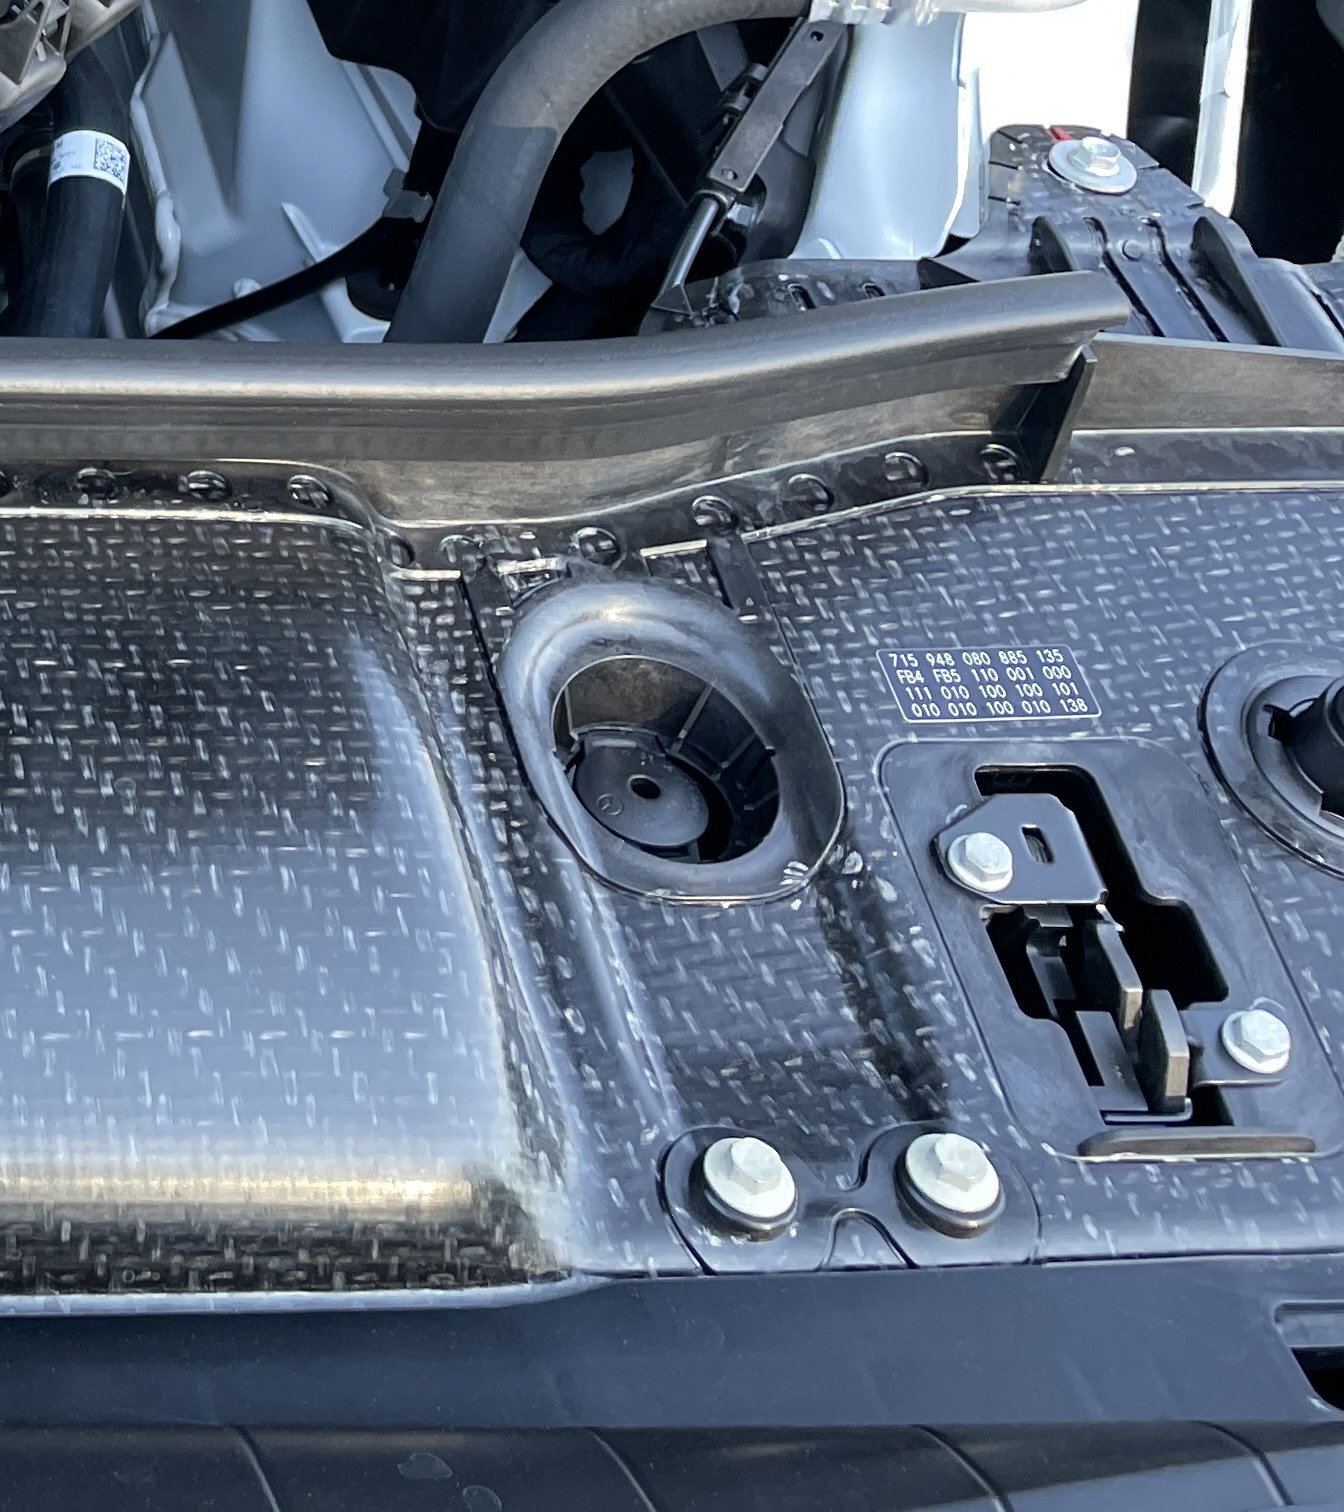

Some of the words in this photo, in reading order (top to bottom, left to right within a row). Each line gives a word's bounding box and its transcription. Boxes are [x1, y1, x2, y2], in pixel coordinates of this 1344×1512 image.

[887, 652, 919, 668] 715
[925, 652, 956, 668] 948
[961, 651, 991, 666] 080
[998, 649, 1028, 665] 885
[1035, 648, 1064, 665] 135
[895, 669, 925, 685] FB4
[932, 668, 962, 684] FB5
[970, 667, 999, 683] 110
[1005, 666, 1035, 682] 001
[1042, 664, 1072, 680] 000
[905, 686, 933, 701] 111
[940, 685, 970, 700] 010
[978, 683, 1007, 699] 100
[1014, 682, 1043, 698] 100
[1051, 681, 1080, 696] 101
[911, 702, 941, 718] 010
[947, 701, 978, 717] 010
[985, 700, 1015, 716] 100
[1021, 699, 1052, 715] 010
[1059, 697, 1089, 714] 138
